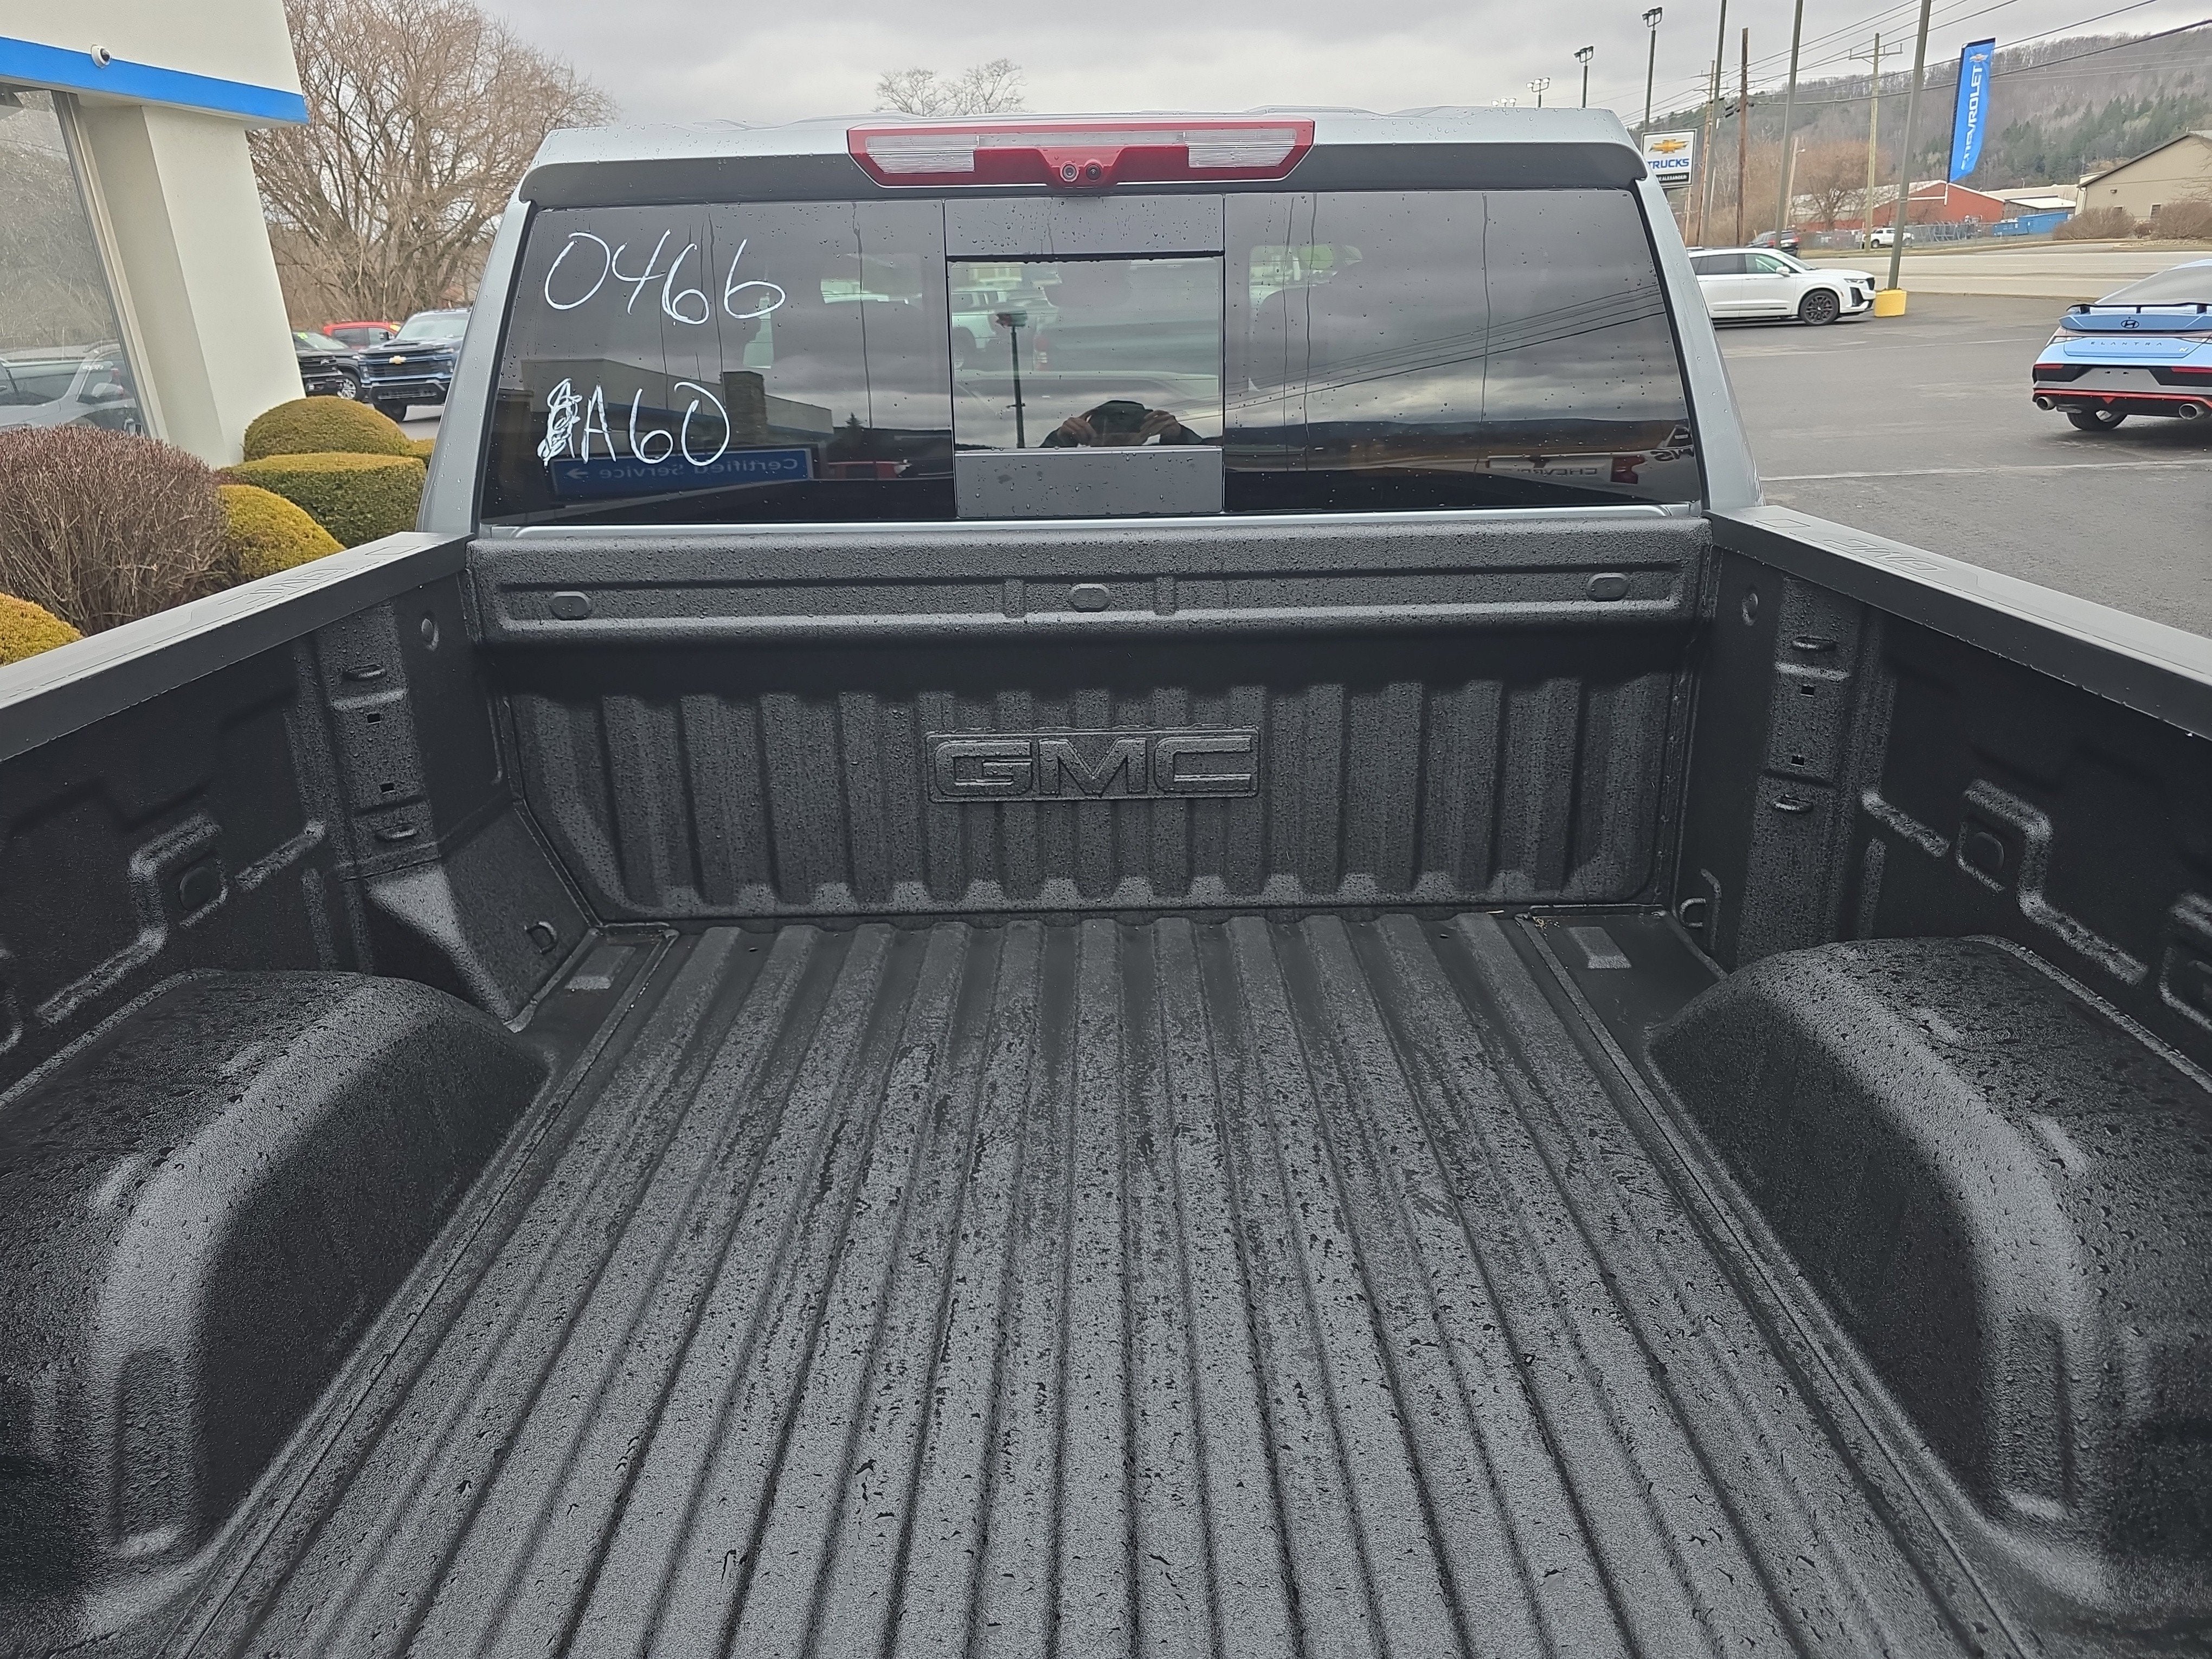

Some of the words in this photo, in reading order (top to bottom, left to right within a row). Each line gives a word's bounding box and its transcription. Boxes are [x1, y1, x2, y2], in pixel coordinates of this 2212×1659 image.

[1647, 158, 1689, 169] TRUCKS
[544, 228, 786, 325] 0466
[1822, 538, 1949, 570] GMC
[217, 568, 348, 605] GMC
[934, 736, 1253, 797] GMC
